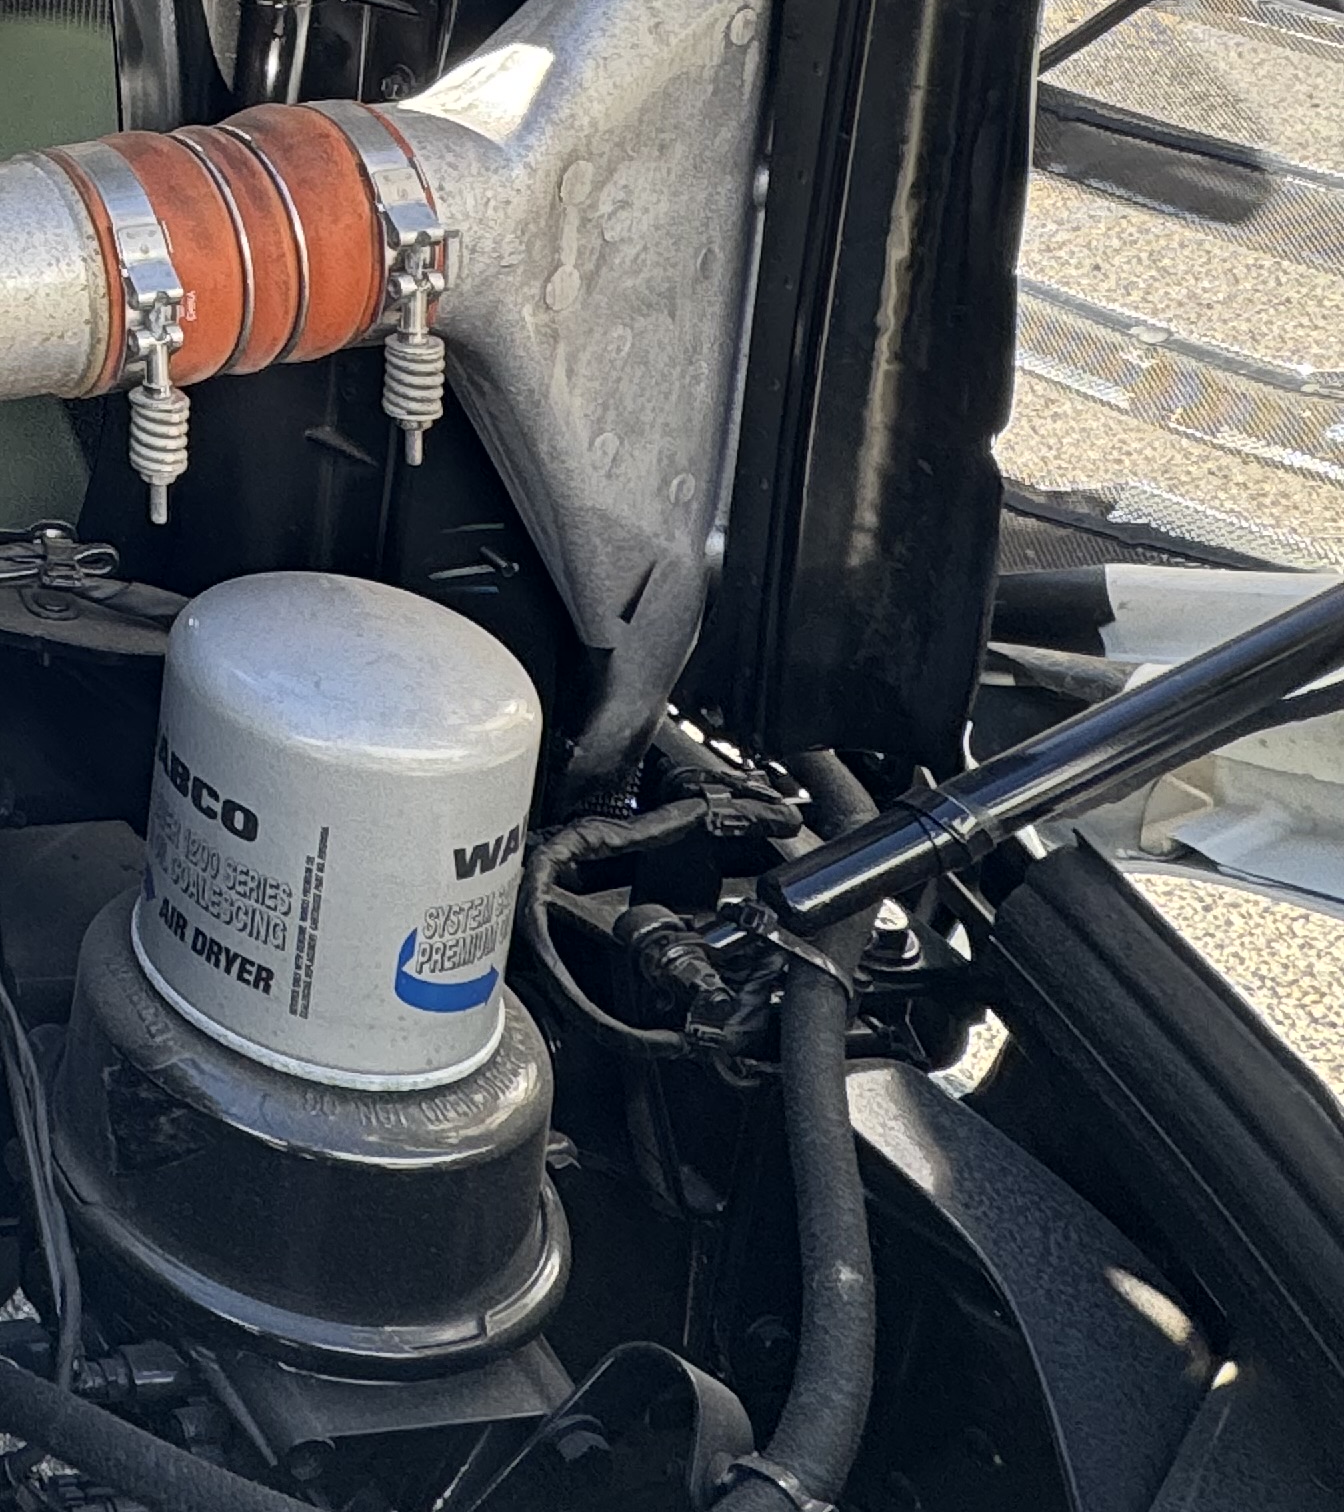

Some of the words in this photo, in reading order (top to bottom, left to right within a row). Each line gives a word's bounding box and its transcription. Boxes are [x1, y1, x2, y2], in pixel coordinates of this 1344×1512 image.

[172, 857, 288, 952] COALESCING
[225, 856, 293, 918] SERIES
[422, 890, 496, 940] SYSTEM
[159, 896, 189, 944] AIR
[191, 926, 275, 996] DRYER
[415, 922, 498, 976] PREMIUM
